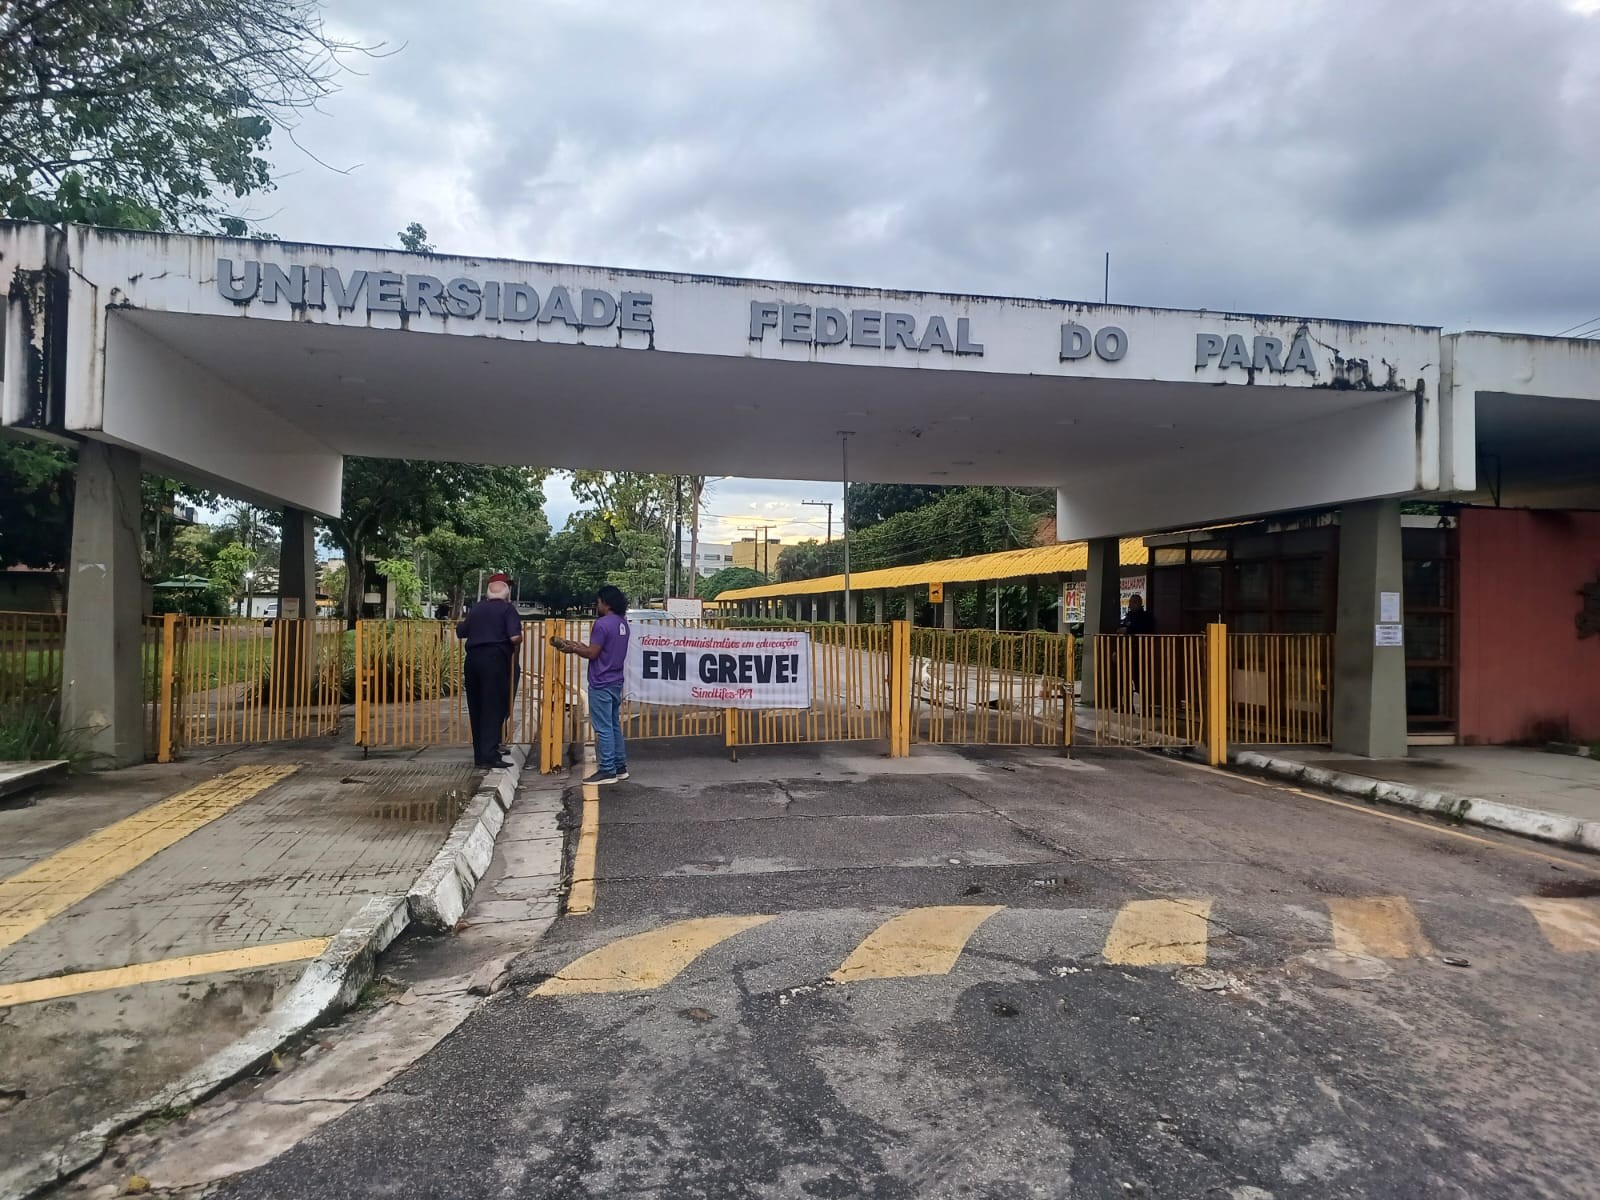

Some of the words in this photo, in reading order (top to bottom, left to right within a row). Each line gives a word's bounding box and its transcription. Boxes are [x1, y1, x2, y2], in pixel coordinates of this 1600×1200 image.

[217, 257, 653, 331] UNIVERSIDADE
[750, 300, 984, 355] FEDERAL
[1060, 323, 1129, 361] DO
[1195, 324, 1318, 374] PARÁ
[741, 640, 754, 648] em
[756, 637, 799, 650] educação
[642, 650, 687, 680] EM
[699, 653, 799, 684] GREVE!
